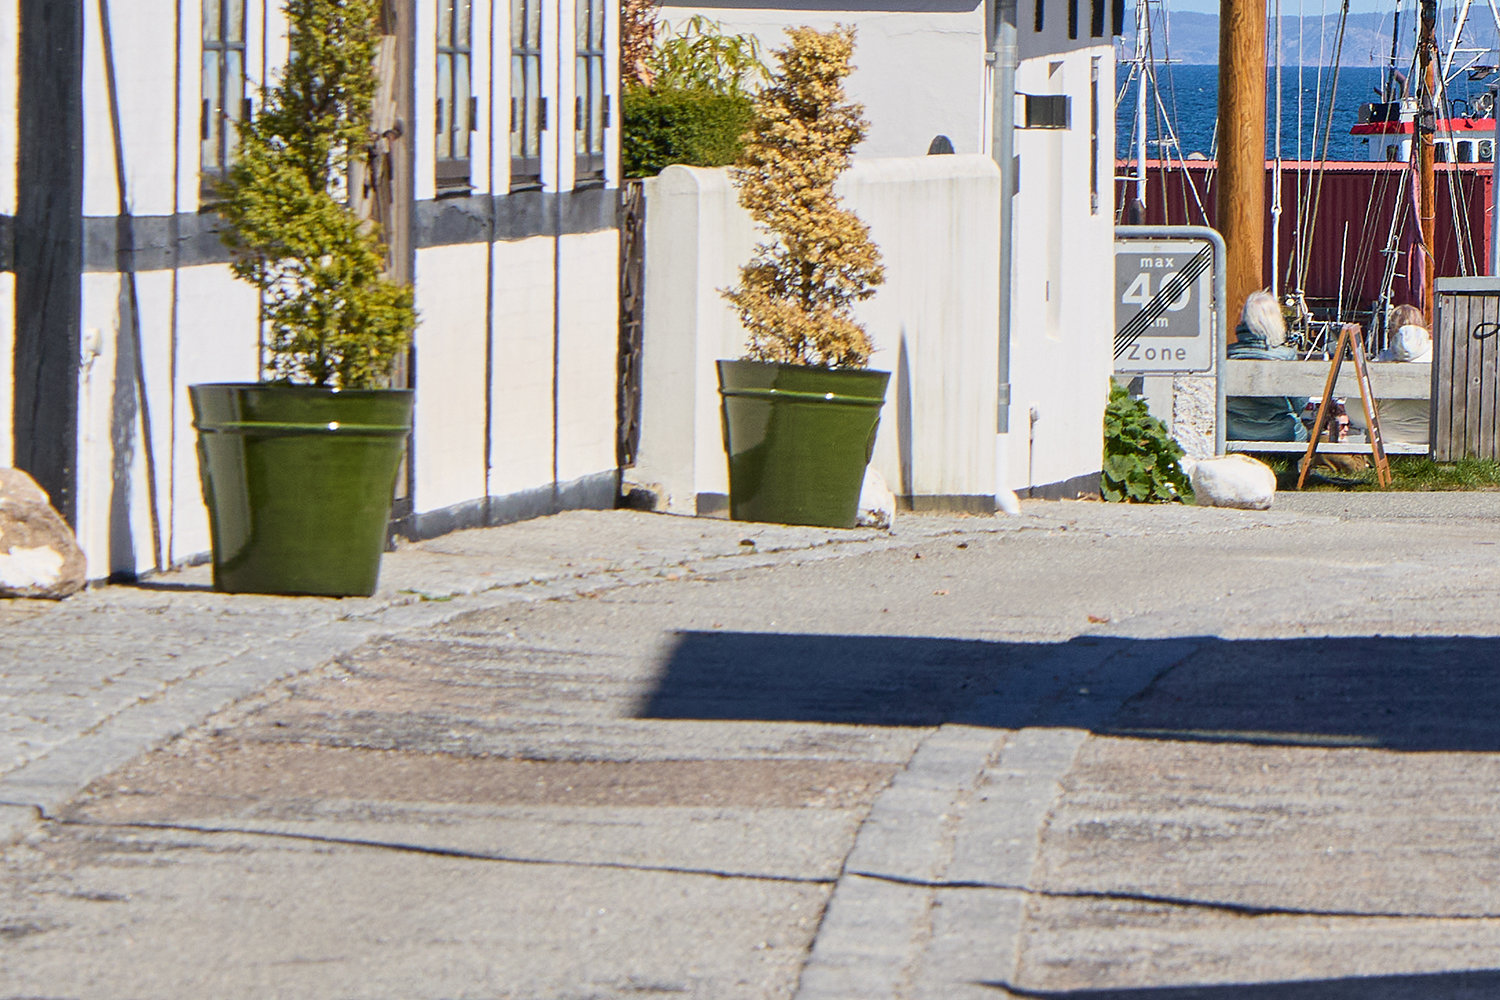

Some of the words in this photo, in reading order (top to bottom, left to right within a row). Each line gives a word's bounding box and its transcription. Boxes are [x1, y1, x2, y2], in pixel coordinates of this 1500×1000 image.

[1140, 257, 1174, 268] max
[1122, 271, 1191, 312] 40
[1127, 343, 1187, 361] Zone
